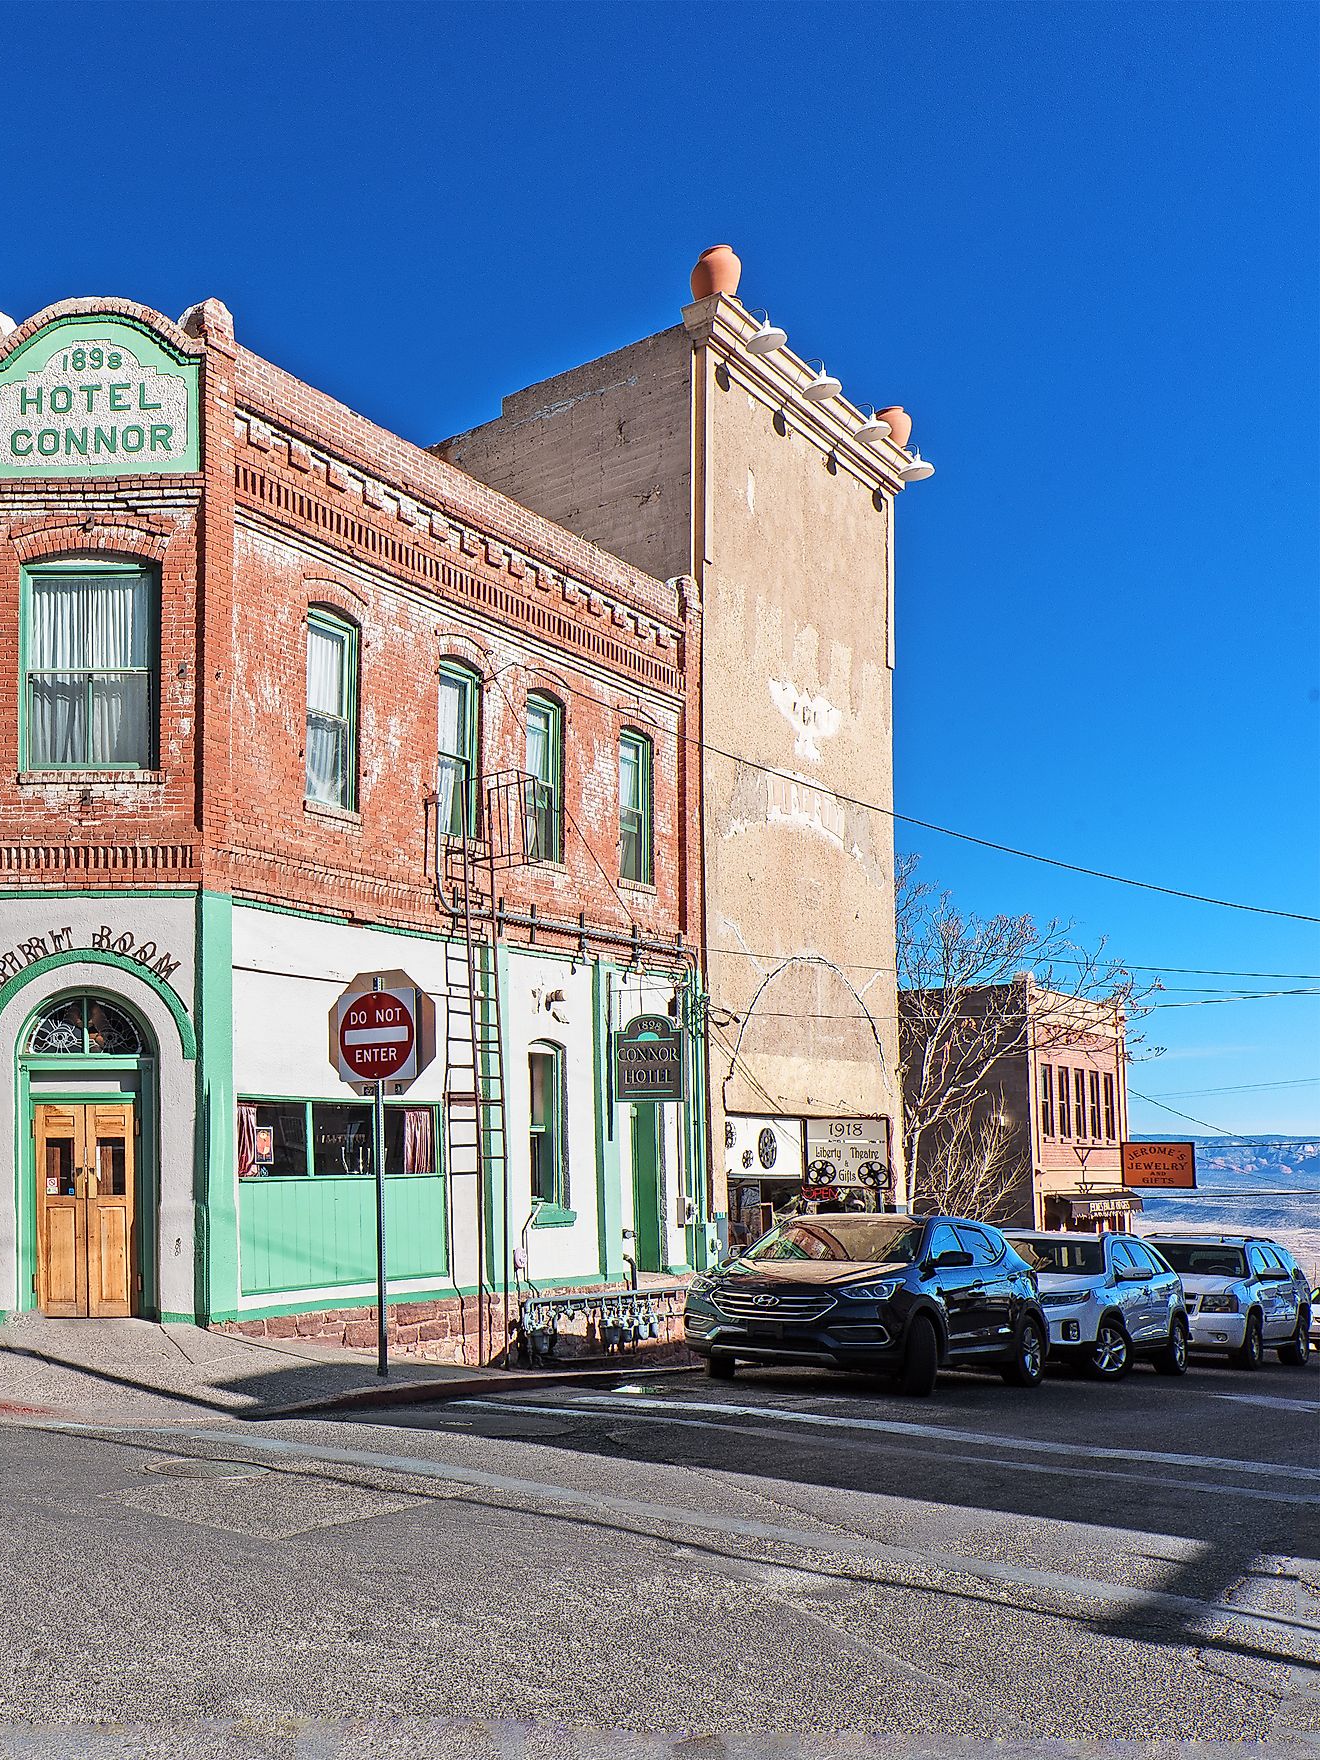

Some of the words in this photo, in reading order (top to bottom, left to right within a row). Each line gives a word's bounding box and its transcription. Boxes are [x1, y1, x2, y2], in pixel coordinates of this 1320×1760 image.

[62, 347, 122, 372] 1898
[20, 382, 162, 415] HOTEL
[11, 424, 174, 456] CONNOR
[92, 926, 181, 984] ROOM
[350, 1011, 367, 1025] DO
[376, 1008, 402, 1023] NOT
[637, 1020, 663, 1031] 1898
[355, 1047, 397, 1063] ENTER
[618, 1047, 680, 1063] CONNOR
[624, 1069, 674, 1085] HOTEL
[829, 1123, 863, 1137] 1918
[815, 1146, 842, 1161] Liberty
[850, 1147, 880, 1160] Theatre
[1128, 1146, 1187, 1161] JEROME'S
[1127, 1161, 1188, 1170] JEWELRY
[838, 1169, 857, 1183] Gifts
[1142, 1177, 1175, 1185] GIFTS
[802, 1187, 839, 1199] OPEN
